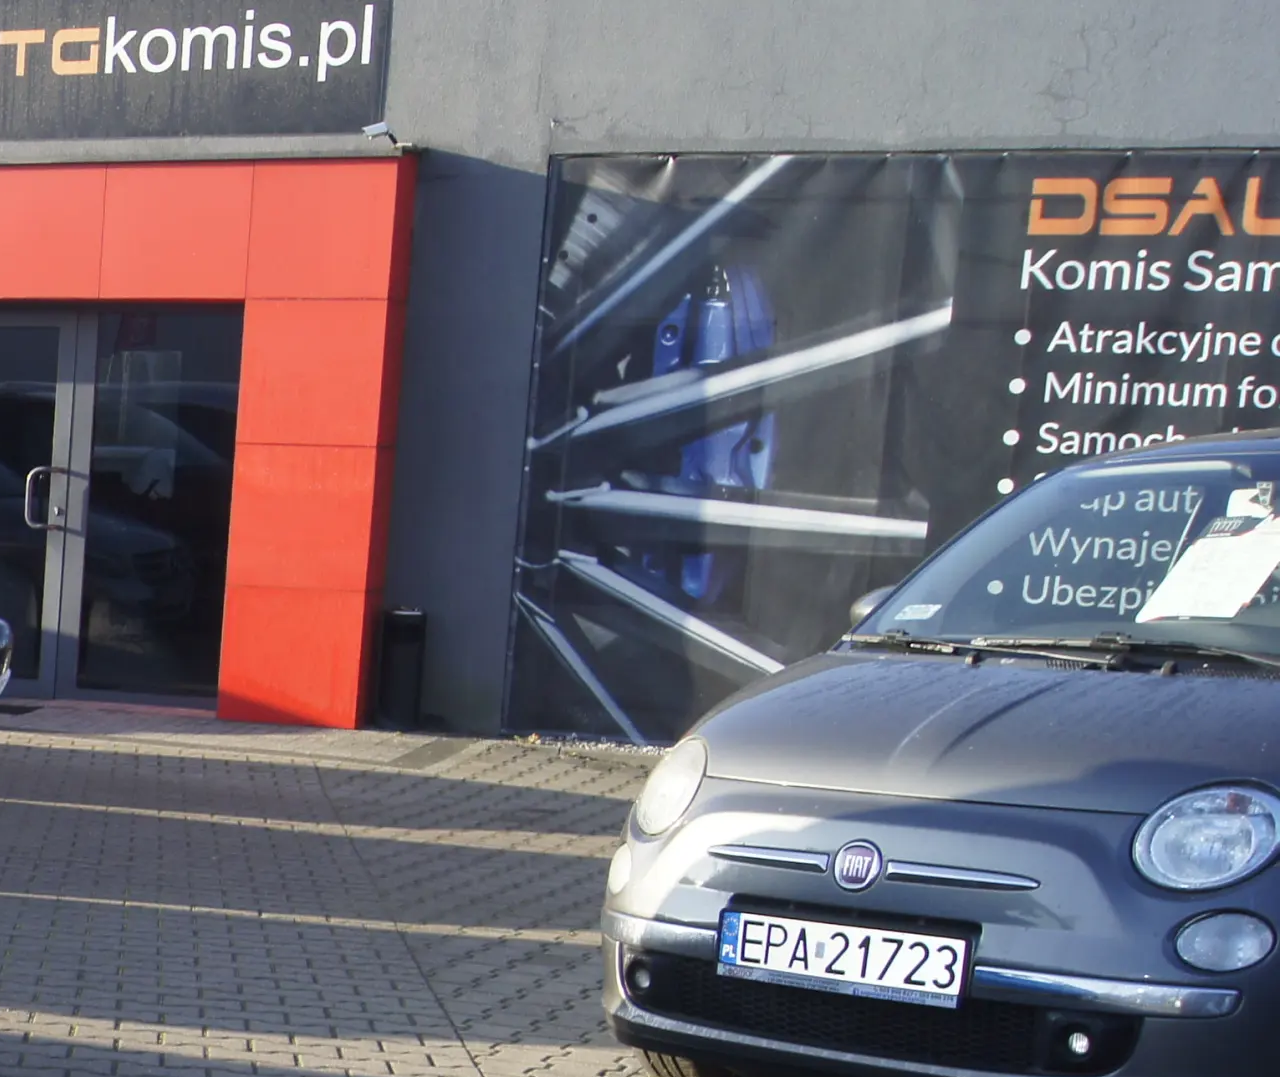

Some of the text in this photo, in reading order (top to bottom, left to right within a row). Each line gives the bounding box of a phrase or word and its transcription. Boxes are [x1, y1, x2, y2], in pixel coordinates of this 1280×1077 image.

[1019, 248, 1171, 292] Komis
[1046, 320, 1262, 363] Atrakcyjne
[1043, 371, 1280, 410] Minimum fo
[1036, 421, 1188, 455] Samoch
[1028, 526, 1179, 568] Wynaje
[1021, 574, 1158, 615] Ubezpi
[842, 854, 873, 879] FIAT
[721, 943, 736, 959] PL
[739, 919, 809, 971] EPA
[824, 931, 959, 990] 21723
